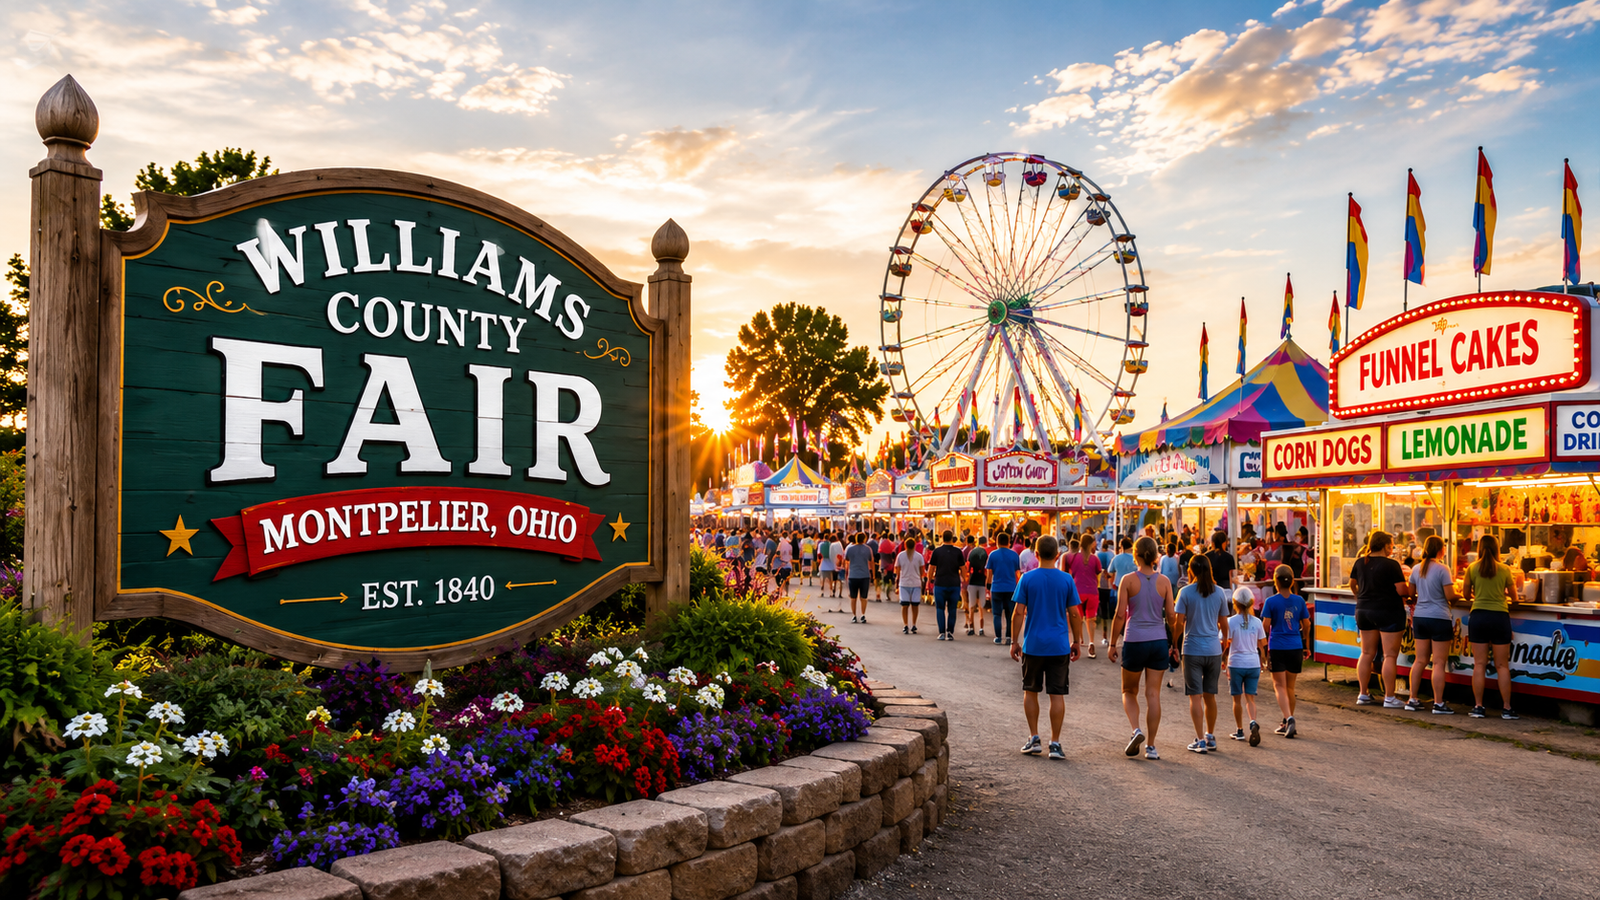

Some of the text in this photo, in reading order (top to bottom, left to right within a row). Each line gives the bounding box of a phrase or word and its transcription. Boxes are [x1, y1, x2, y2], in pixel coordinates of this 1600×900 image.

[236, 218, 591, 341] WILLIAMS
[326, 291, 528, 354] COUNTY
[1359, 319, 1539, 391] FUNNEL CAKES
[210, 336, 612, 487] FAIR
[1401, 417, 1528, 460] LEMONADE
[1273, 440, 1317, 471] CORN
[1322, 433, 1372, 467] DOGS
[1563, 432, 1600, 451] DRI
[259, 500, 578, 554] MONTPELIER, OHIO
[361, 575, 495, 610] EST. 1840
